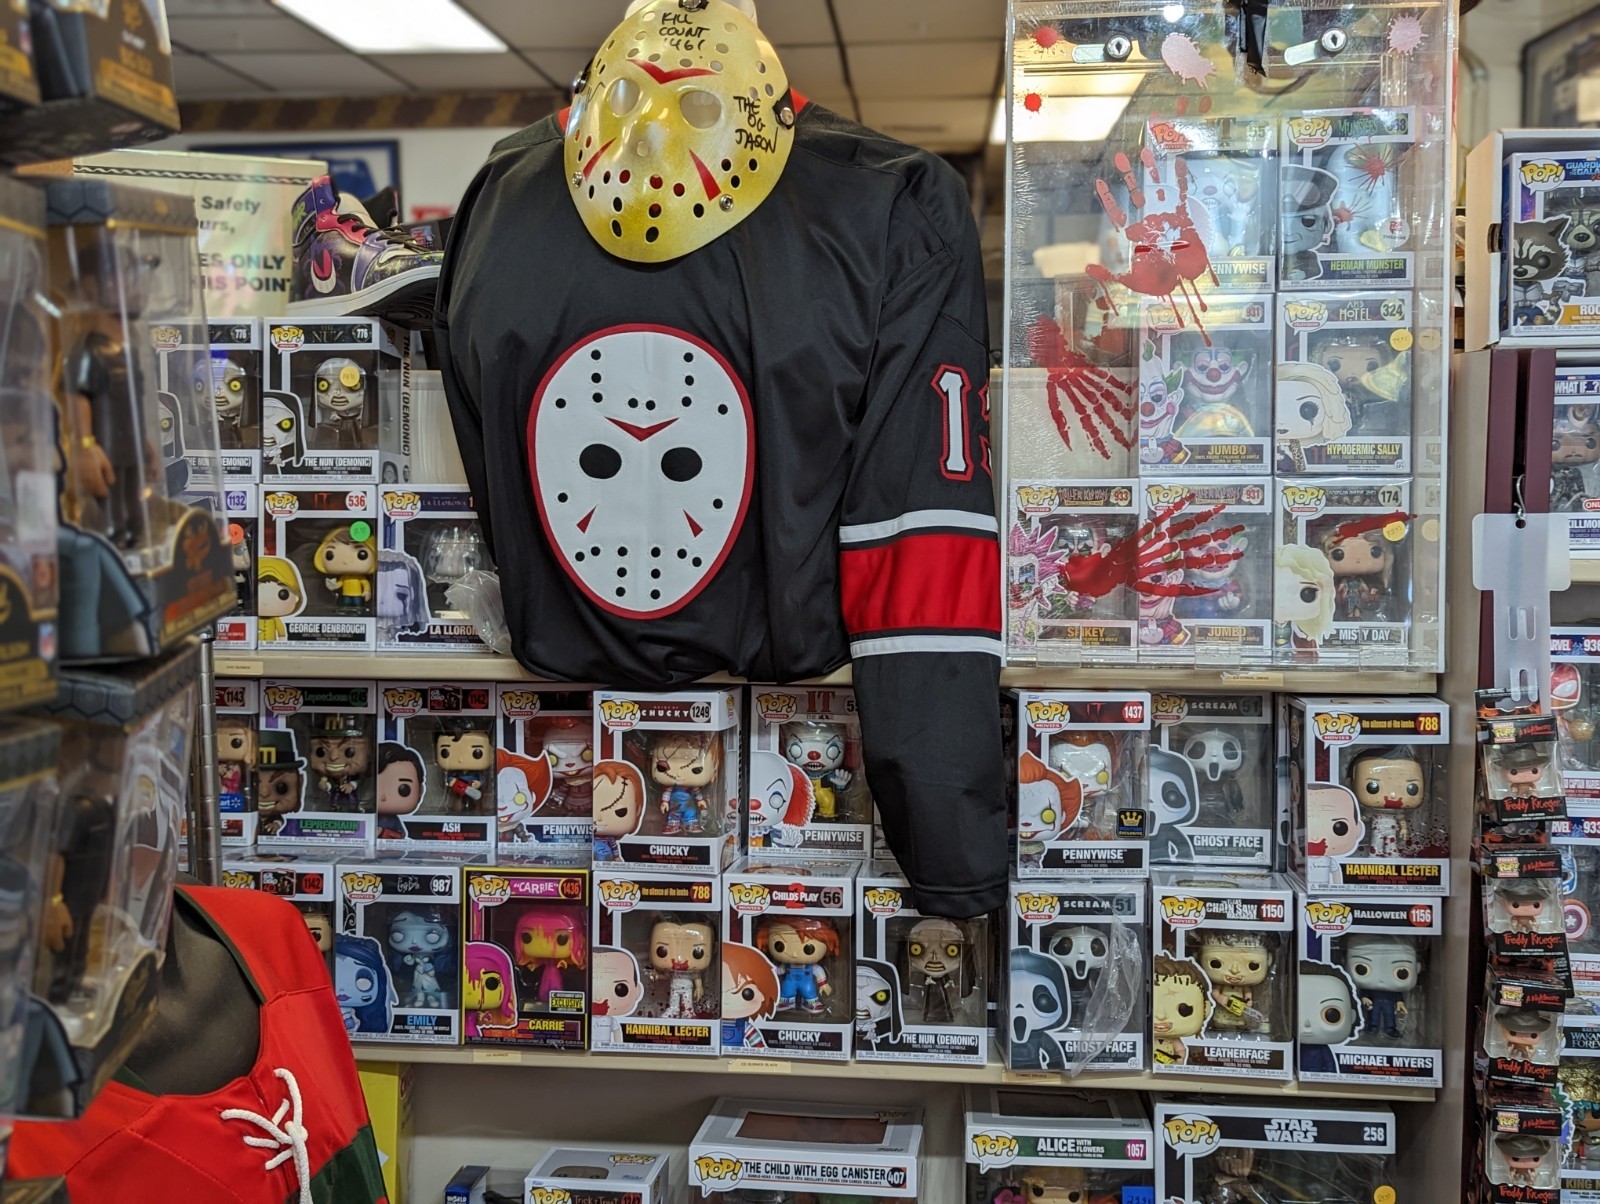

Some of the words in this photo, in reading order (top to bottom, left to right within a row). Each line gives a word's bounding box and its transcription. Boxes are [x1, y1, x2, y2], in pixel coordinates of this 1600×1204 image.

[661, 12, 693, 25] KILL
[659, 27, 711, 38] COUNT
[734, 96, 761, 115] THE
[747, 115, 766, 132] OG
[1289, 119, 1331, 138] POP!
[735, 128, 778, 153] JASON
[1520, 164, 1564, 185] POP!
[202, 196, 260, 214] Safety
[231, 255, 285, 270] ONLY
[1331, 260, 1364, 271] HERMAN
[1367, 259, 1405, 270] MUNSTER
[235, 277, 292, 292] POIN
[1284, 303, 1327, 321] POP!
[1339, 308, 1371, 321] HOTEL
[1383, 304, 1403, 317] 324
[272, 326, 303, 343] POP!
[356, 328, 368, 339] 776
[402, 336, 410, 359] THE
[402, 361, 411, 388] NUN
[1555, 381, 1579, 394] WHAT
[402, 392, 411, 457] (DEMONIC)
[931, 364, 990, 481] 1
[1208, 444, 1247, 455] JUMBO
[1327, 444, 1376, 455] HYPODERMIC
[1377, 444, 1400, 455] SALLY
[305, 459, 317, 467] THE
[319, 459, 333, 468] NUN
[335, 459, 372, 468] (DEMONIC)
[228, 495, 246, 508] 1132
[266, 493, 297, 509] POP!
[348, 495, 366, 507] 536
[383, 492, 420, 511] POP!
[1016, 487, 1057, 506] POP!
[1246, 489, 1261, 500] 931
[1282, 487, 1325, 507] POP!
[1381, 490, 1400, 503] 174
[289, 624, 320, 634] GEORGIE
[321, 624, 366, 634] DENBROUGH
[430, 625, 442, 635] LA
[1207, 627, 1247, 637] JUMBO
[1372, 629, 1391, 640] DAY
[226, 691, 245, 703] 1143
[266, 687, 301, 705] POP!
[384, 690, 421, 708] POP!
[501, 692, 539, 711] POP!
[806, 691, 836, 713] IT
[756, 693, 797, 714] POP!
[1191, 702, 1238, 710] SCREAM
[600, 701, 640, 721] POP!
[641, 709, 689, 718] CHUCKY
[692, 705, 710, 719] 1249
[1025, 703, 1069, 723] POP!
[1124, 706, 1143, 719] 1437
[1314, 714, 1359, 735] POP!
[1418, 717, 1439, 731] 788
[1503, 798, 1529, 813] Freddy
[1530, 796, 1562, 812] Krueger
[442, 823, 461, 833] ASH
[805, 831, 862, 843] PENNYWISE
[1193, 836, 1229, 847] GHOST
[1232, 836, 1261, 848] FACE
[649, 845, 690, 857] CHUCKY
[1062, 849, 1124, 860] PENNYWISE
[1346, 864, 1398, 876] HANNIBAL
[1401, 865, 1439, 876] LECTER
[342, 874, 382, 893] POP!
[432, 879, 450, 892] 987
[470, 877, 510, 896] POP!
[562, 882, 579, 895] 1436
[598, 881, 640, 900] POP!
[692, 885, 710, 899] 788
[729, 884, 769, 905] POP!
[800, 892, 820, 902] PLAY
[823, 892, 841, 905] 56
[865, 889, 901, 908] POP!
[1015, 894, 1059, 914] POP!
[1063, 900, 1111, 909] SCREAM
[1118, 899, 1133, 912] 51
[1160, 897, 1205, 918] POP!
[1261, 904, 1284, 919] 1150
[1304, 903, 1352, 924] POP!
[1353, 909, 1408, 920] HALLOWEEN
[1411, 909, 1431, 923] 1156
[1503, 932, 1529, 948] Freddy
[1530, 932, 1562, 949] Krueger
[407, 1015, 438, 1026] EMILY
[528, 1019, 565, 1031] CARRIE
[626, 1024, 672, 1036] HANNIBAL
[675, 1025, 709, 1037] LECTER
[778, 1030, 822, 1042] CHUCKY
[902, 1034, 918, 1045] THE
[919, 1034, 936, 1045] NUN
[937, 1034, 978, 1046] (DEMONIC)
[1065, 1041, 1101, 1053] GHOST
[1105, 1042, 1134, 1053] FACE
[1204, 1047, 1271, 1060] LEATHERFACE
[1339, 1054, 1390, 1067] MICHAEL
[1392, 1055, 1433, 1069] MYERS
[1496, 1059, 1521, 1075] Freddy
[1523, 1061, 1554, 1079] Krueger
[1264, 1118, 1318, 1131] STAR
[1163, 1118, 1219, 1146] POP!
[1265, 1129, 1318, 1143] WARS
[1363, 1127, 1386, 1142] 258
[973, 1135, 1019, 1158] POP!
[1037, 1137, 1076, 1153] ALICE
[1076, 1139, 1092, 1147] WITH
[1076, 1146, 1105, 1154] FLOWERS
[1127, 1143, 1145, 1158] 1057
[695, 1156, 743, 1181] POP!
[744, 1161, 761, 1174] THE
[765, 1163, 791, 1176] CHILD
[794, 1164, 817, 1177] WITH
[821, 1166, 839, 1179] EGG
[842, 1167, 886, 1181] CANISTER
[887, 1169, 905, 1185] 407
[1565, 1178, 1592, 1190] KING
[1499, 1185, 1523, 1201] Freddy
